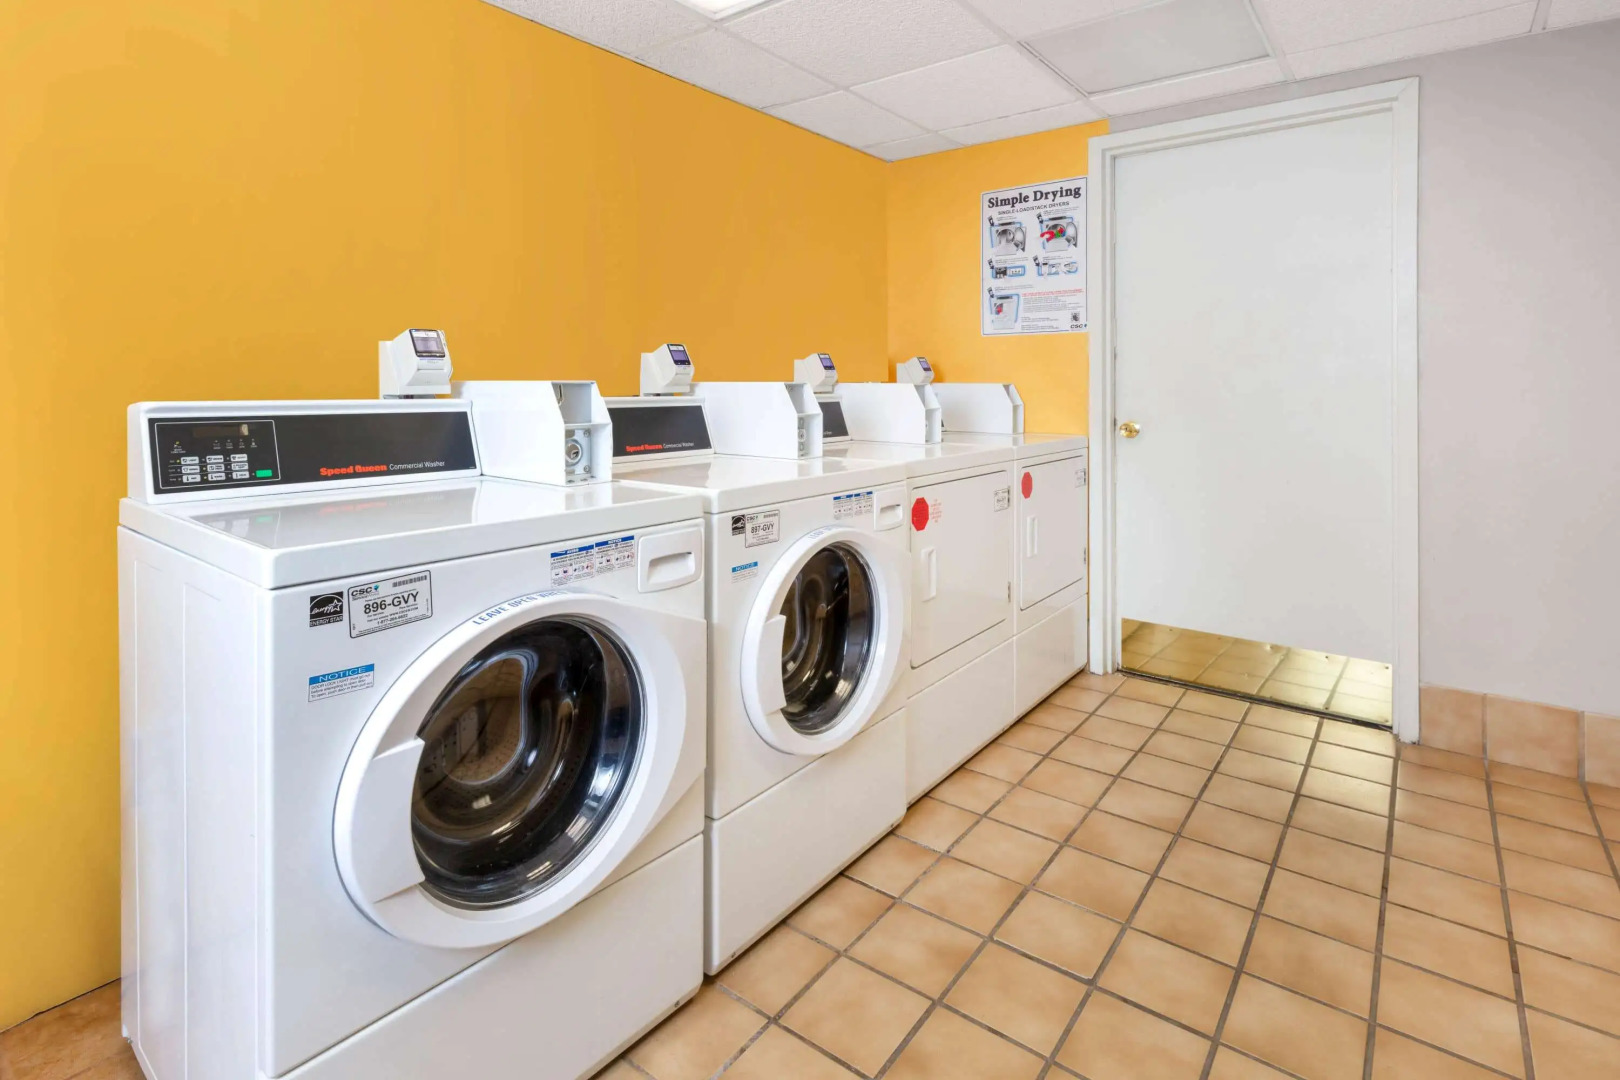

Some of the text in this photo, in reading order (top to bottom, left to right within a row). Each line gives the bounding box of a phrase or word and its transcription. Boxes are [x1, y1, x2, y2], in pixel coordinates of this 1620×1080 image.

[988, 186, 1082, 208] Simple Drying
[320, 465, 354, 476] Speed
[355, 464, 388, 473] Queen
[389, 462, 423, 470] Commercial
[751, 522, 774, 534] 897-GVY
[351, 587, 372, 597] CSC
[364, 591, 419, 614] 896-GVY
[472, 606, 509, 625] LEAVE
[508, 596, 538, 608] OPEN
[310, 618, 329, 627] ENERGY
[320, 666, 366, 682] NOTICE
